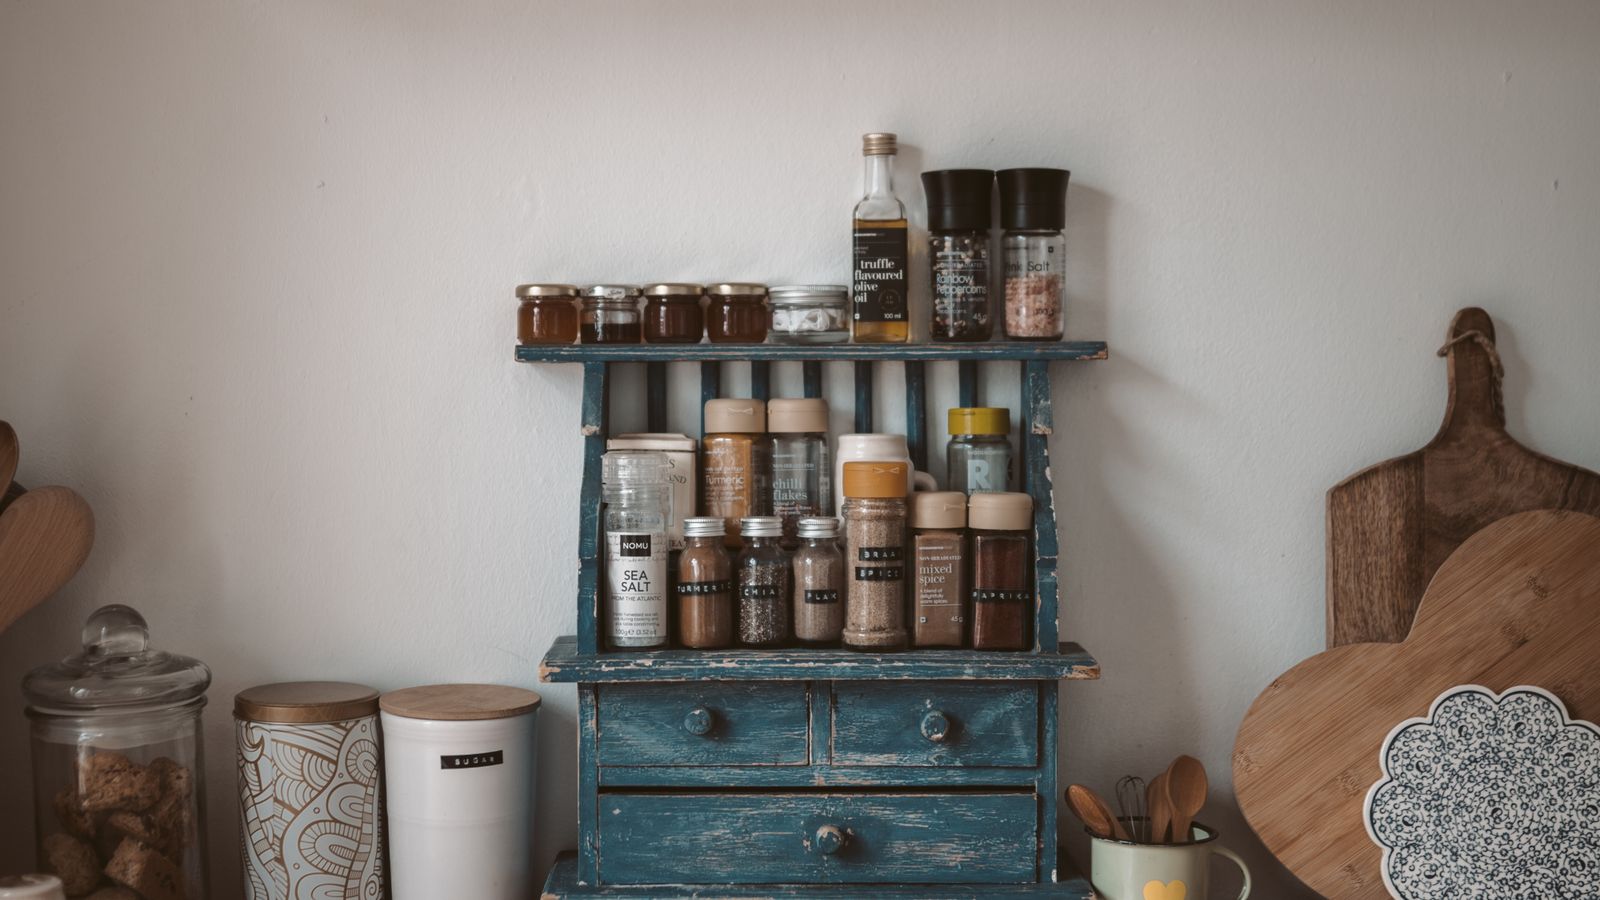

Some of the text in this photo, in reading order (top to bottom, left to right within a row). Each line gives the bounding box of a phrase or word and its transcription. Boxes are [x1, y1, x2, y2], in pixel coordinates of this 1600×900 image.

[860, 258, 895, 269] truffle
[1027, 260, 1050, 272] Salt
[854, 269, 903, 280] flavoured
[936, 272, 974, 284] Rainbow
[854, 281, 878, 292] olive
[854, 292, 867, 303] oil
[705, 474, 744, 485] Turmeric
[967, 459, 992, 489] R
[773, 489, 808, 501] flakes
[622, 542, 649, 550] NOMU
[919, 563, 952, 574] mixed
[624, 570, 648, 581] SEA
[919, 573, 945, 586] spice
[621, 581, 651, 592] SALT
[744, 588, 775, 596] CHIA
[455, 756, 494, 766] SUGAR
